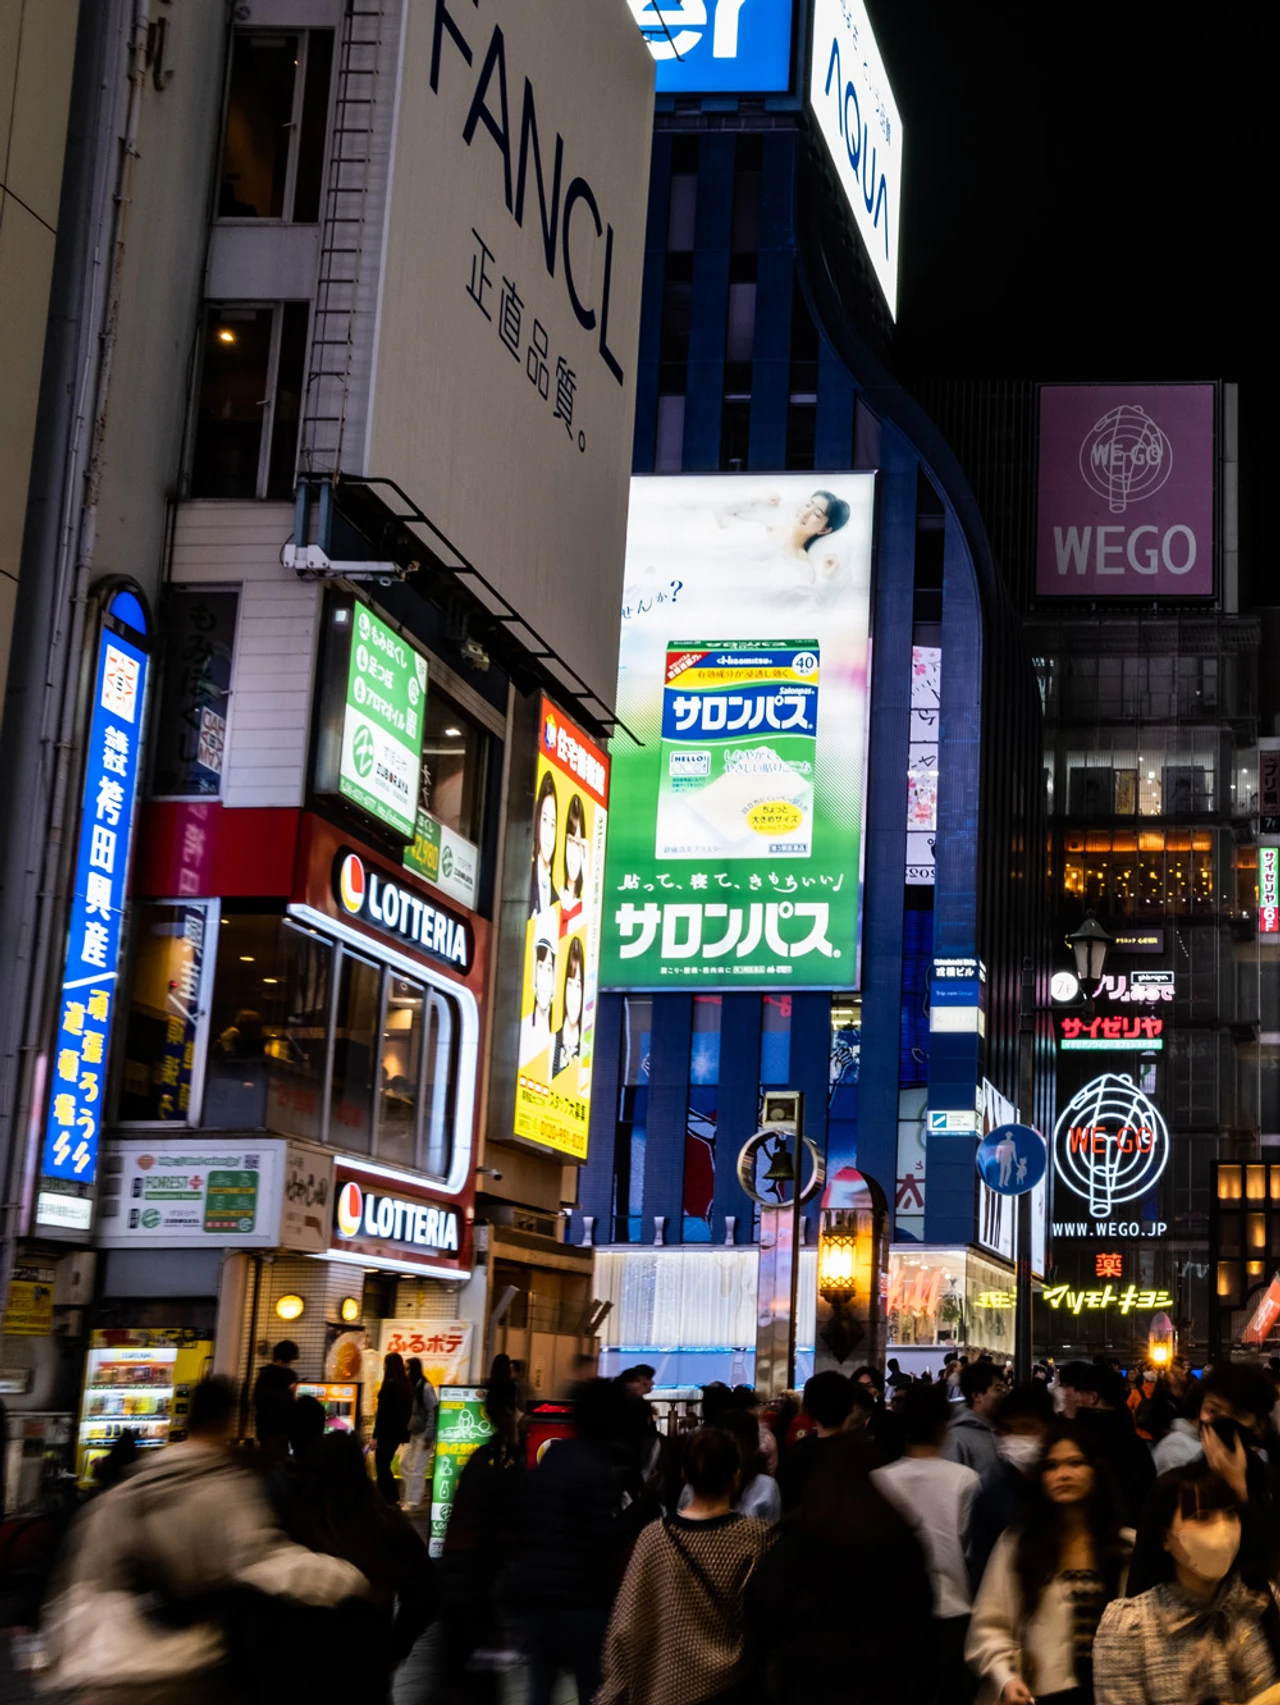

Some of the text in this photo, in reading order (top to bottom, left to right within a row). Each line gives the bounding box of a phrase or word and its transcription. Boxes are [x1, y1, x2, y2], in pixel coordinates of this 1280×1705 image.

[430, 0, 624, 388] FANCL
[465, 227, 586, 453] 正直品質。
[1053, 524, 1197, 575] WEGO
[796, 657, 814, 668] 40
[672, 696, 810, 731] サロンパス
[368, 874, 467, 967] LOTTERIA
[615, 901, 834, 959] サロンパス
[1061, 1016, 1163, 1039] サイゼリヤ
[1068, 1127, 1154, 1154] WE GO
[364, 1193, 459, 1252] LOTTERIA
[1052, 1222, 1168, 1237] WWW.WEGO.JP
[1095, 1253, 1123, 1277] 薬
[1043, 1284, 1174, 1315] マツモトキヨシ
[386, 1333, 463, 1354] ふるポテ
